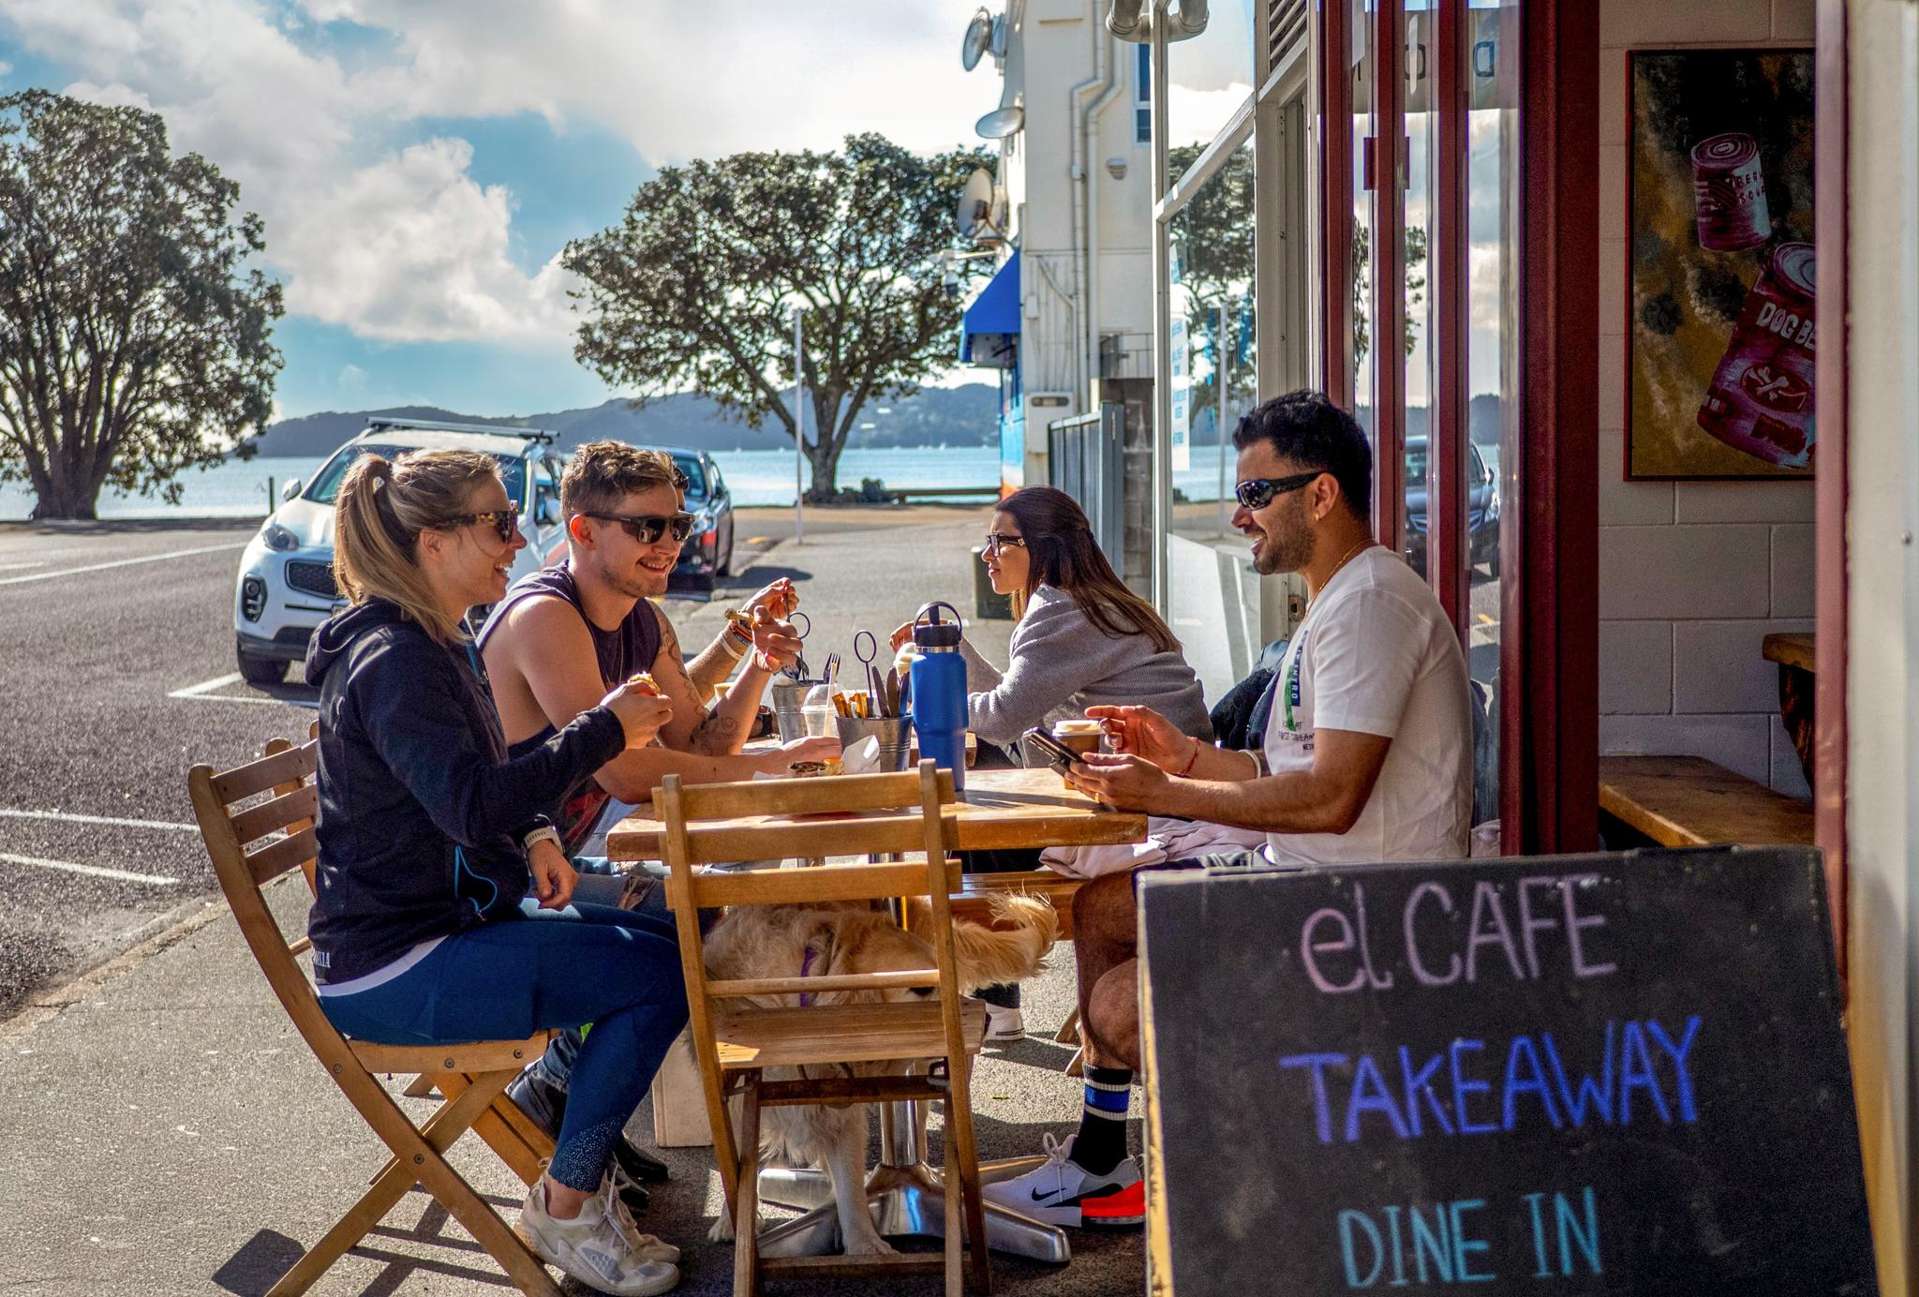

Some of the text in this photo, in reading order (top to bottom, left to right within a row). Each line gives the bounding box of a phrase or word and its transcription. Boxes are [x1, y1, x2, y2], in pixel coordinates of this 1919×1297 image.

[1756, 302, 1799, 340] DOG
[1300, 874, 1618, 993] el CAFE
[1280, 1015, 1702, 1145] TAKEAWAY
[1337, 1187, 1602, 1289] DINE IN
